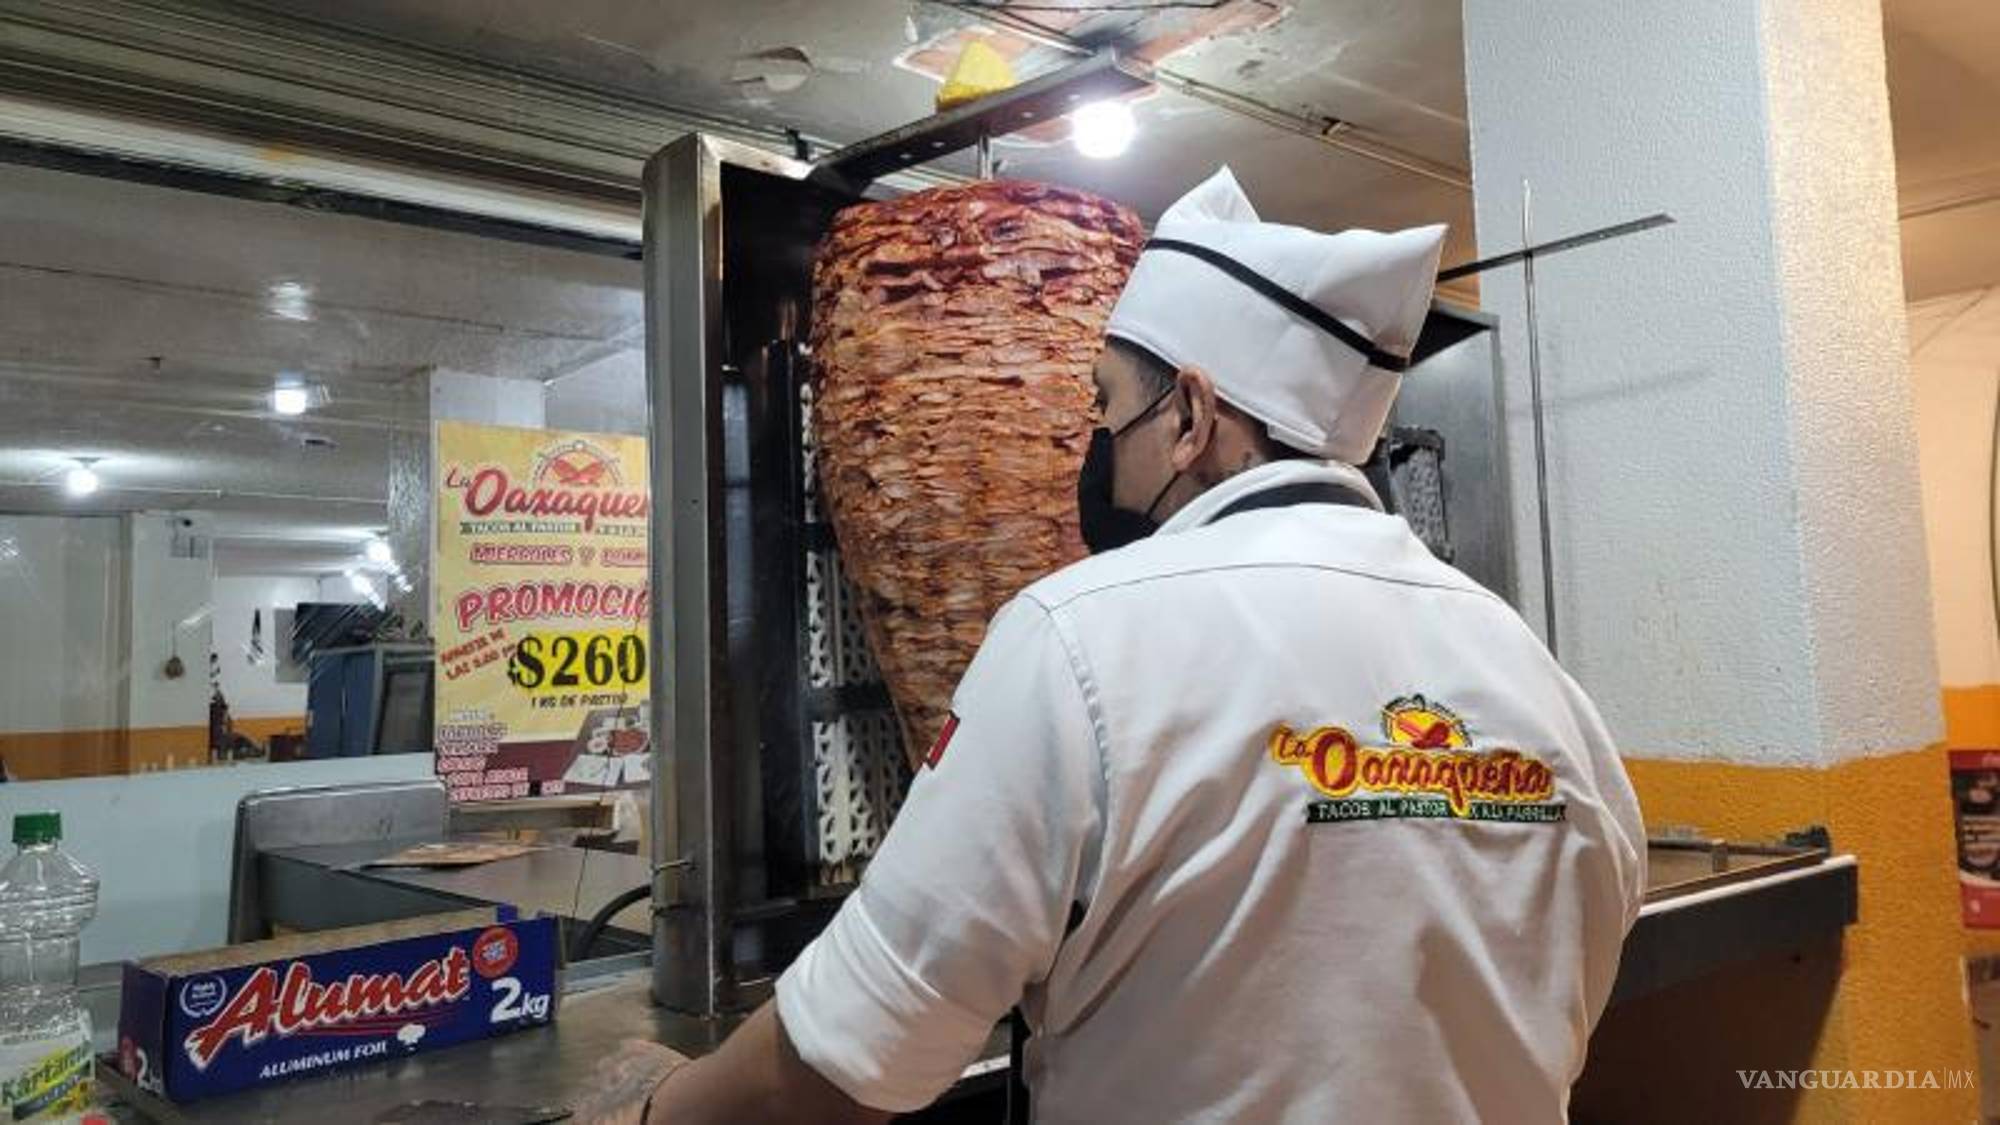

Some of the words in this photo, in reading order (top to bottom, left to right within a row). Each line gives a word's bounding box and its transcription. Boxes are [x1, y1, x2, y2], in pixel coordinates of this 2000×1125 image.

[508, 633, 646, 690] $260
[1318, 801, 1371, 820] TACOS
[1378, 798, 1397, 816] AL
[1400, 799, 1449, 817] PASTOR
[185, 947, 471, 1068] Alumat
[259, 1048, 350, 1079] ALUMINUM
